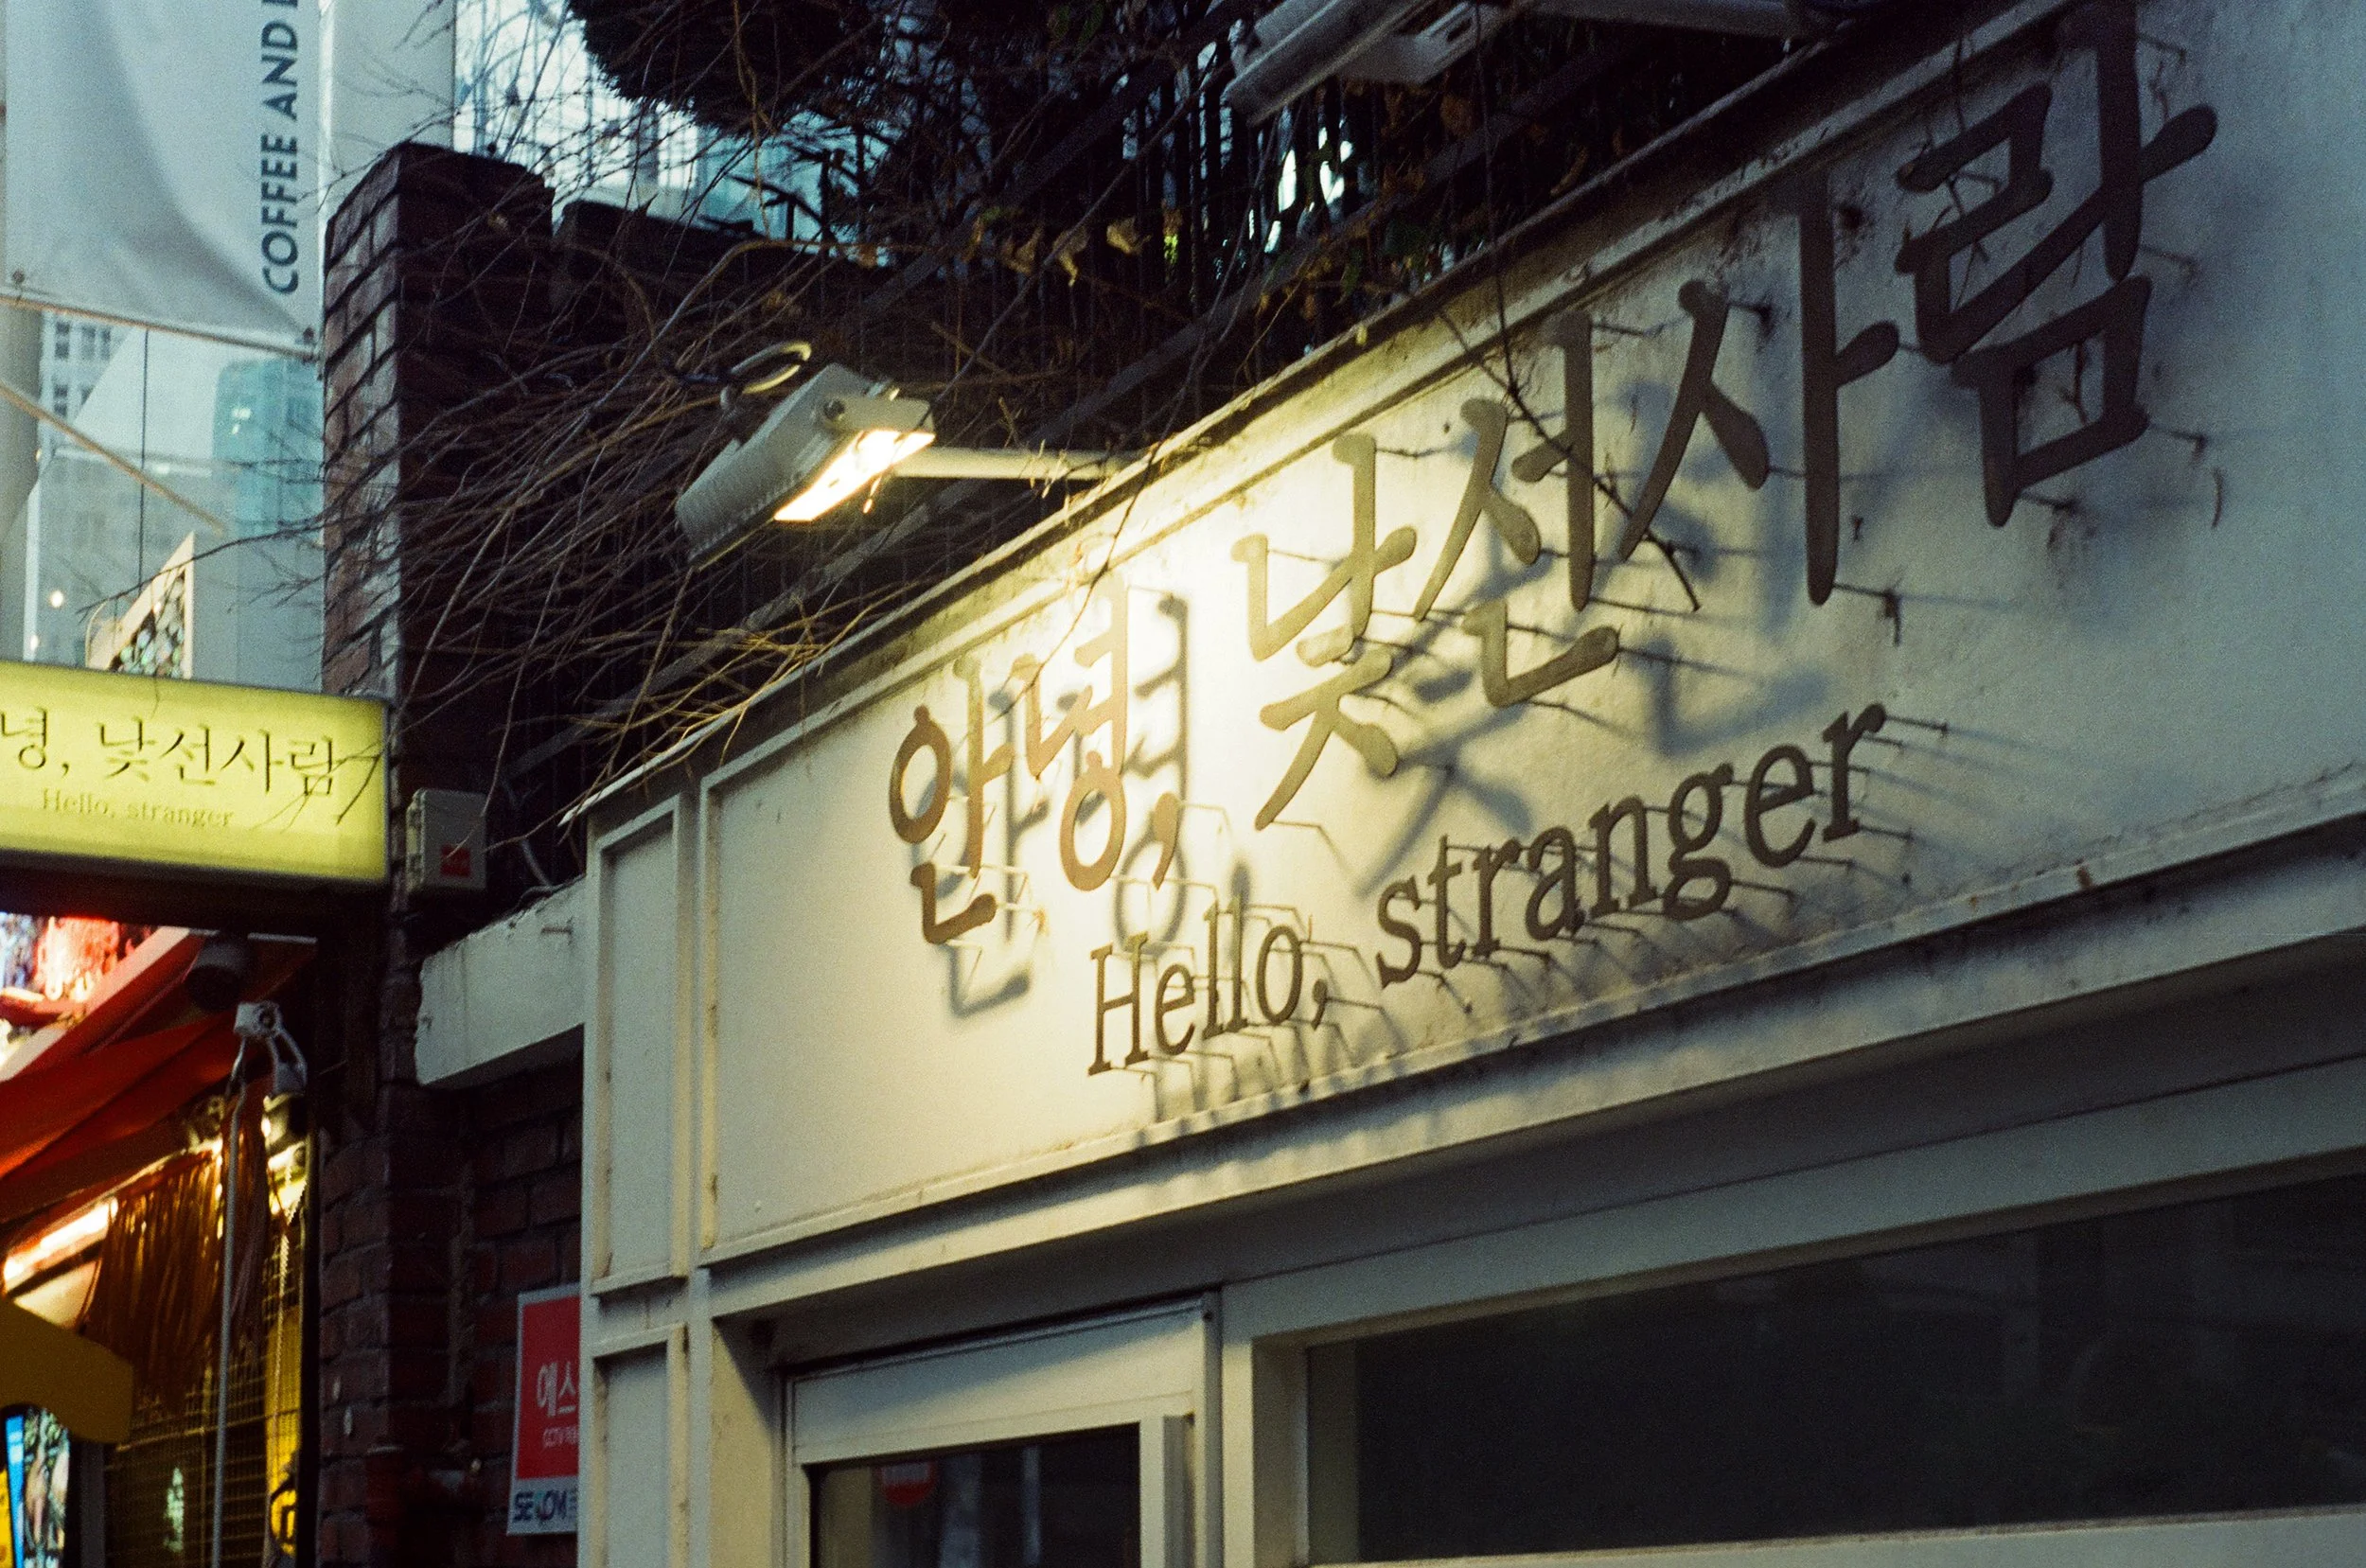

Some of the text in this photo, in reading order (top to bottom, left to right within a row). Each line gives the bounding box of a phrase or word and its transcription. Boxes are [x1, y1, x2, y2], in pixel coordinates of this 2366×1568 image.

[260, 20, 298, 121] AND
[260, 133, 299, 295] COFFEE
[42, 787, 235, 828] Hello, stranger
[888, 572, 1181, 944] 안녕,
[1086, 702, 1887, 1076] Hello, stranger
